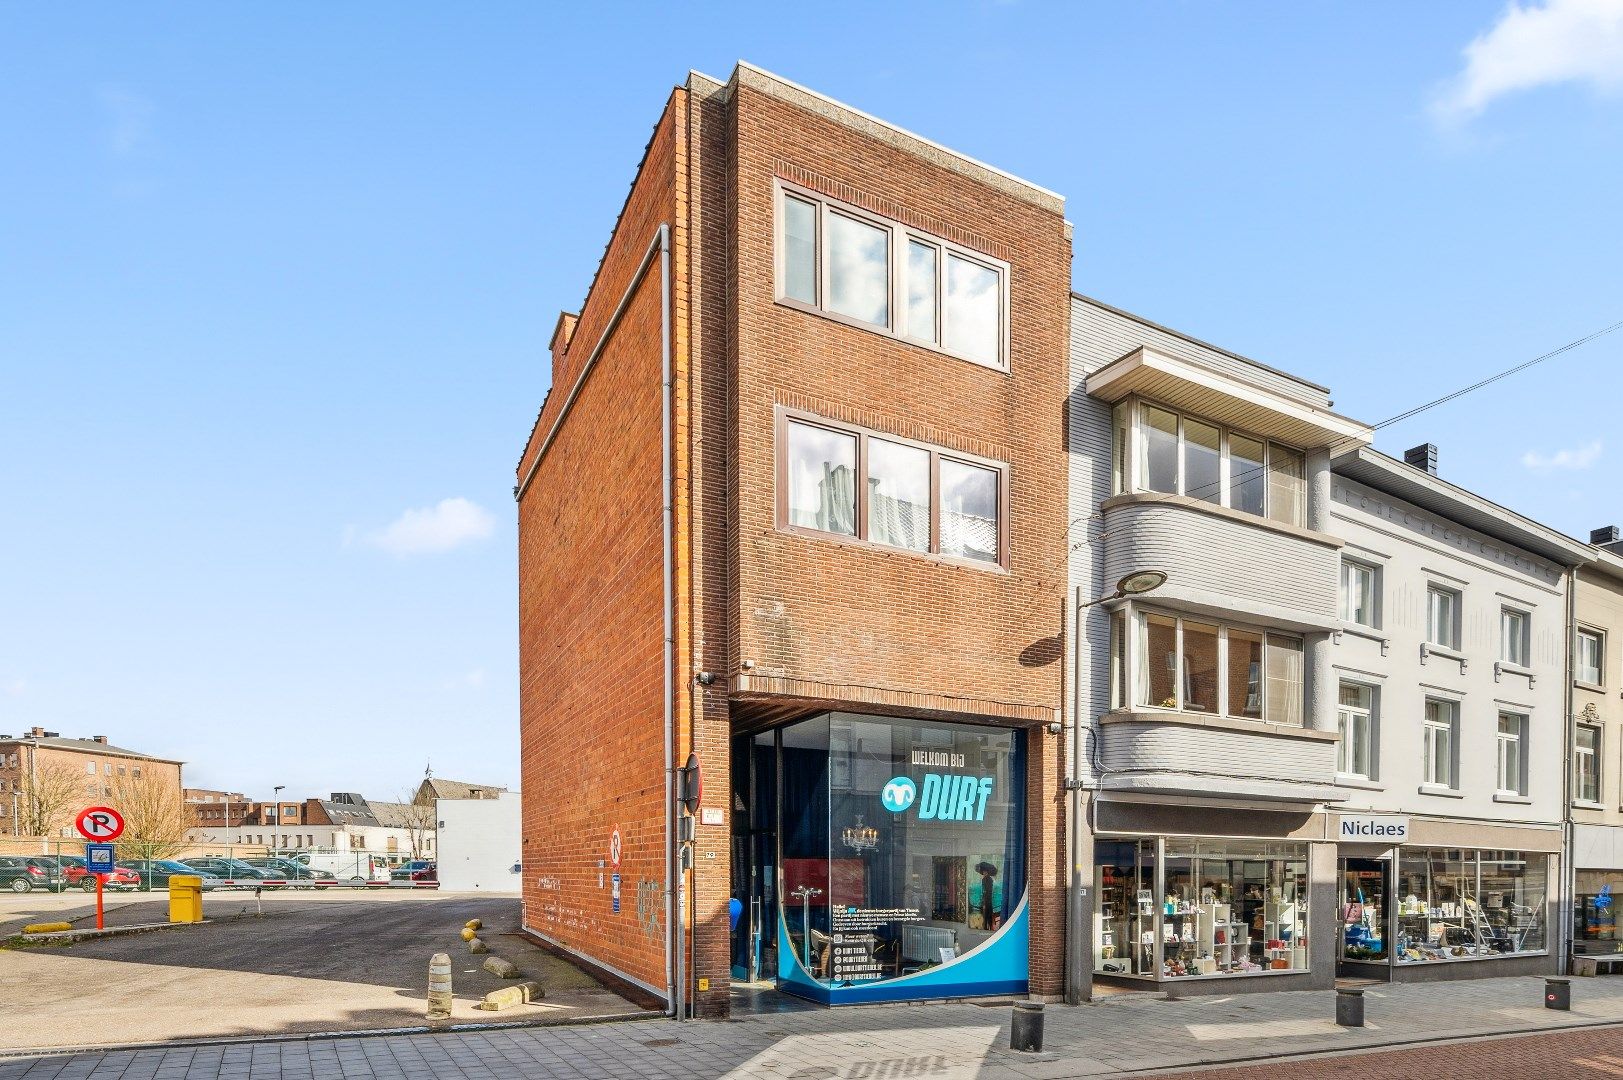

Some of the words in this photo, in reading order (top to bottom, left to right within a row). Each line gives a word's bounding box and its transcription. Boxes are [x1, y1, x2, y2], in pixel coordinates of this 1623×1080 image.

[911, 750, 949, 767] WELKOM
[950, 753, 965, 768] BIJ
[92, 814, 110, 833] P
[1342, 820, 1405, 836] Niclaes
